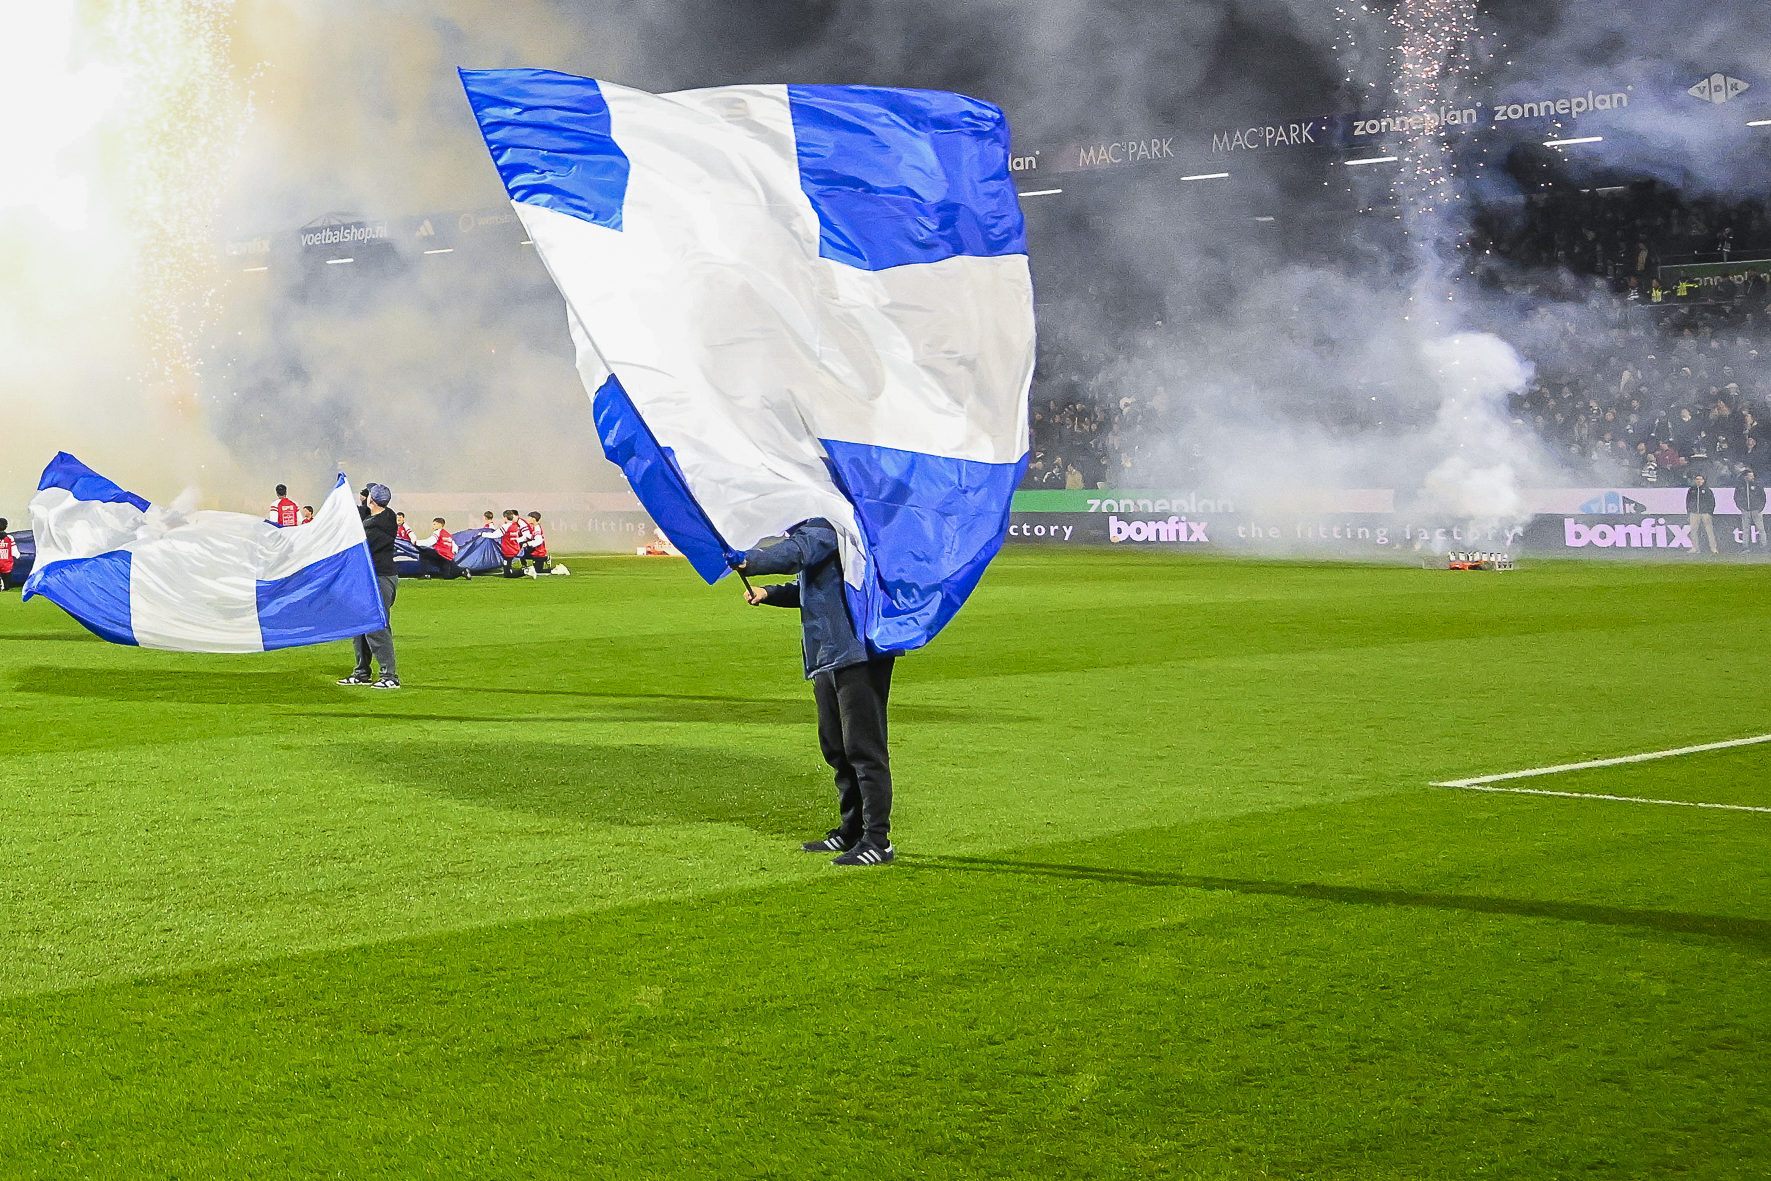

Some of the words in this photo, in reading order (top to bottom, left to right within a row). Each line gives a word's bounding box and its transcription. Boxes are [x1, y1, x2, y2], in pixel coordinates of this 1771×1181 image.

[1494, 90, 1628, 121] zonneplan
[1353, 105, 1477, 136] zonneplan
[301, 222, 388, 248] voetbalshop.nl
[1109, 515, 1209, 542] bonfix
[1237, 522, 1280, 538] the
[1296, 522, 1389, 545] fitting
[1564, 518, 1693, 548] bonfix
